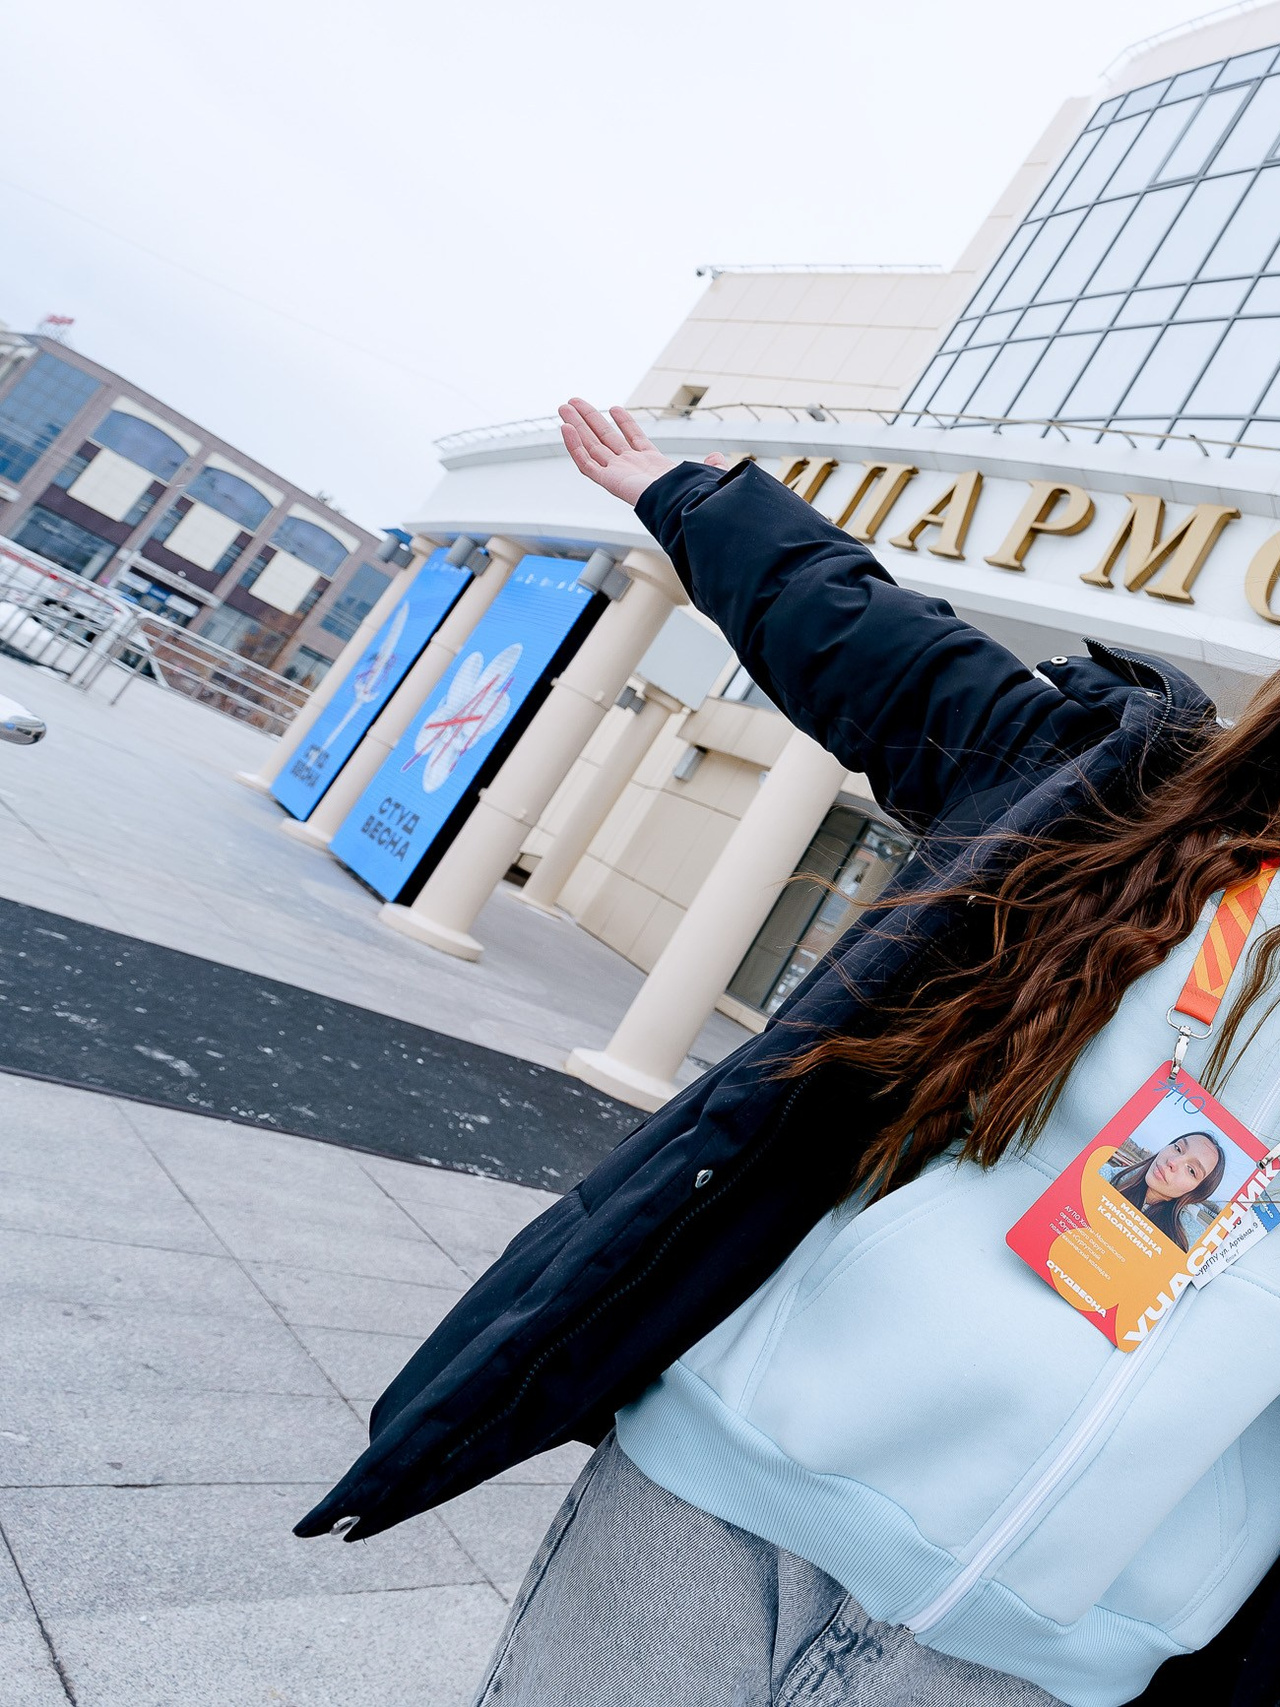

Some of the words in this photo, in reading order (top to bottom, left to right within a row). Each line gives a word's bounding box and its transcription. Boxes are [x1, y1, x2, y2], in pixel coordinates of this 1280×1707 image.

[361, 814, 410, 862] ВЕСНА
[379, 797, 420, 835] СТУД
[1070, 1211, 1080, 1220] ПО
[1097, 1205, 1153, 1258] КАСАТКИНА
[1101, 1195, 1163, 1255] ТИМОФЕЕВНА
[1121, 1202, 1154, 1235] МАРИЯ
[1219, 1248, 1230, 1258] ул.
[1252, 1221, 1259, 1229] 9
[1122, 1161, 1280, 1341] УЧАСТНИК
[1046, 1259, 1107, 1318] СТУДВЕСНА
